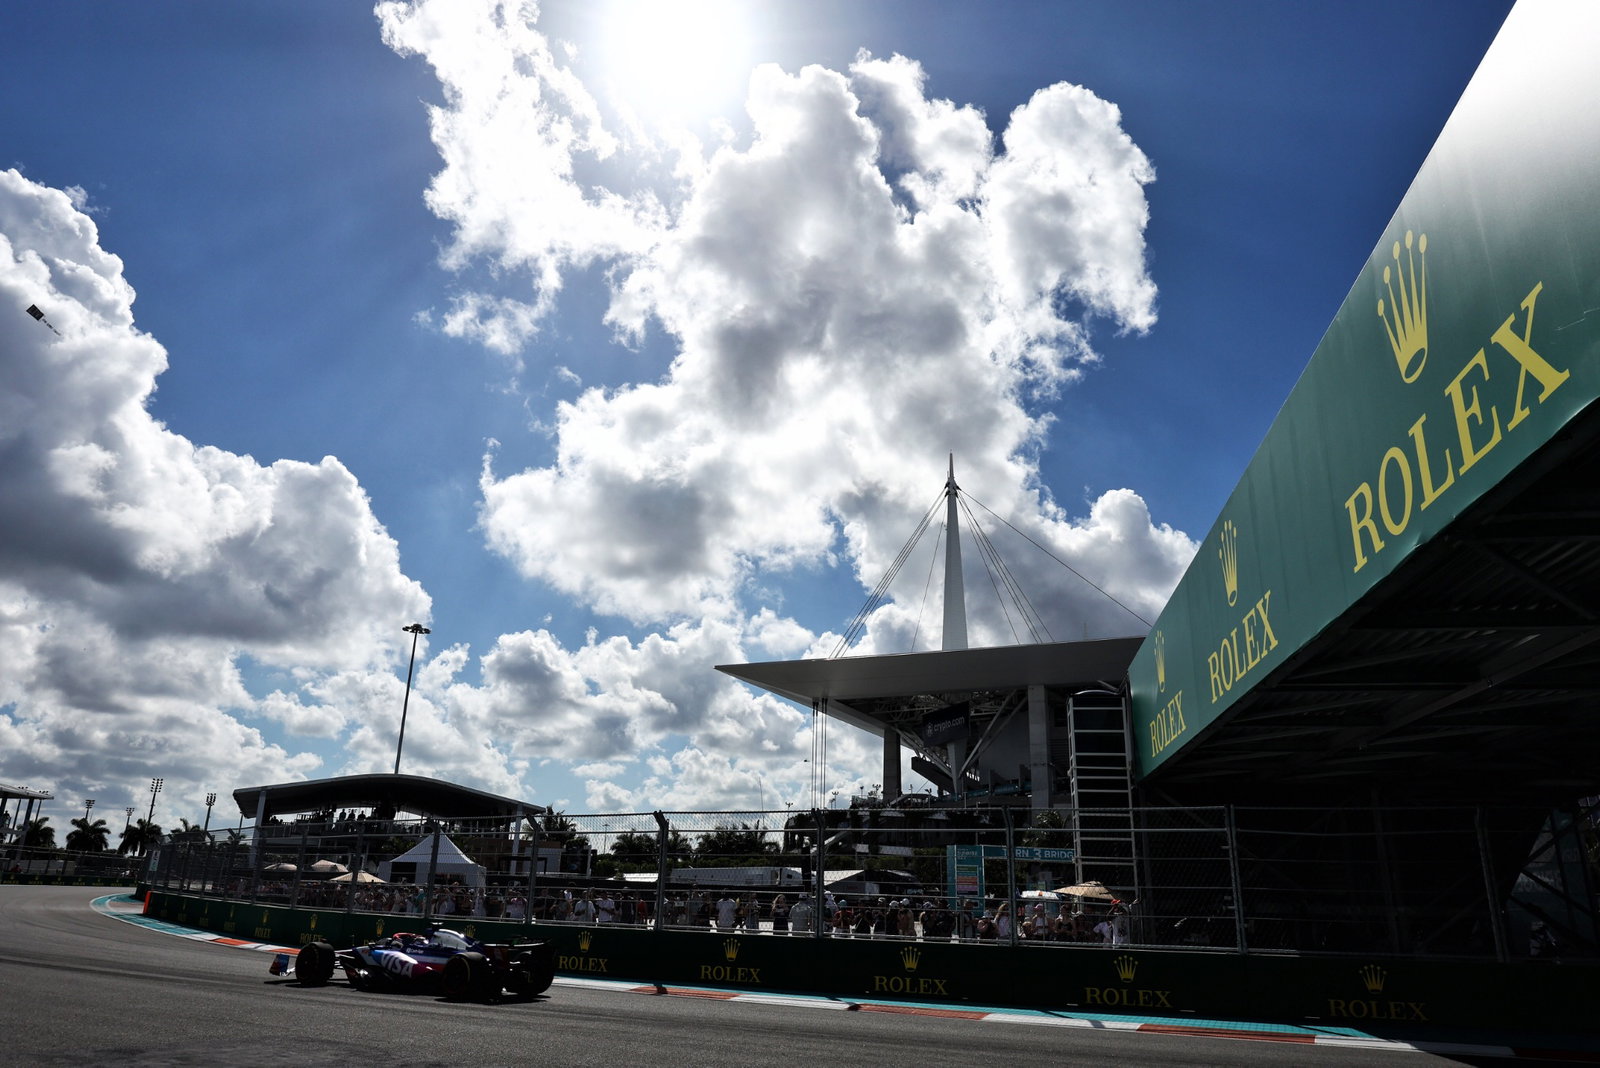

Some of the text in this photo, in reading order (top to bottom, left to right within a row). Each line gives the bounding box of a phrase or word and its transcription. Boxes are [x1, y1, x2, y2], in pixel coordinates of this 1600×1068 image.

[1345, 281, 1570, 574] ROLEX
[1207, 590, 1278, 704] ROLEX
[933, 716, 965, 732] crypto.com
[1149, 690, 1186, 758] ROLEX
[1002, 848, 1029, 857] TRN
[1045, 850, 1074, 858] BRIDG
[380, 953, 413, 978] VISA
[558, 955, 608, 973] ROLEX
[700, 964, 761, 984] ROLEX
[873, 975, 949, 997] ROLEX
[1084, 986, 1172, 1009] ROLEX
[1328, 998, 1430, 1023] ROLEX
